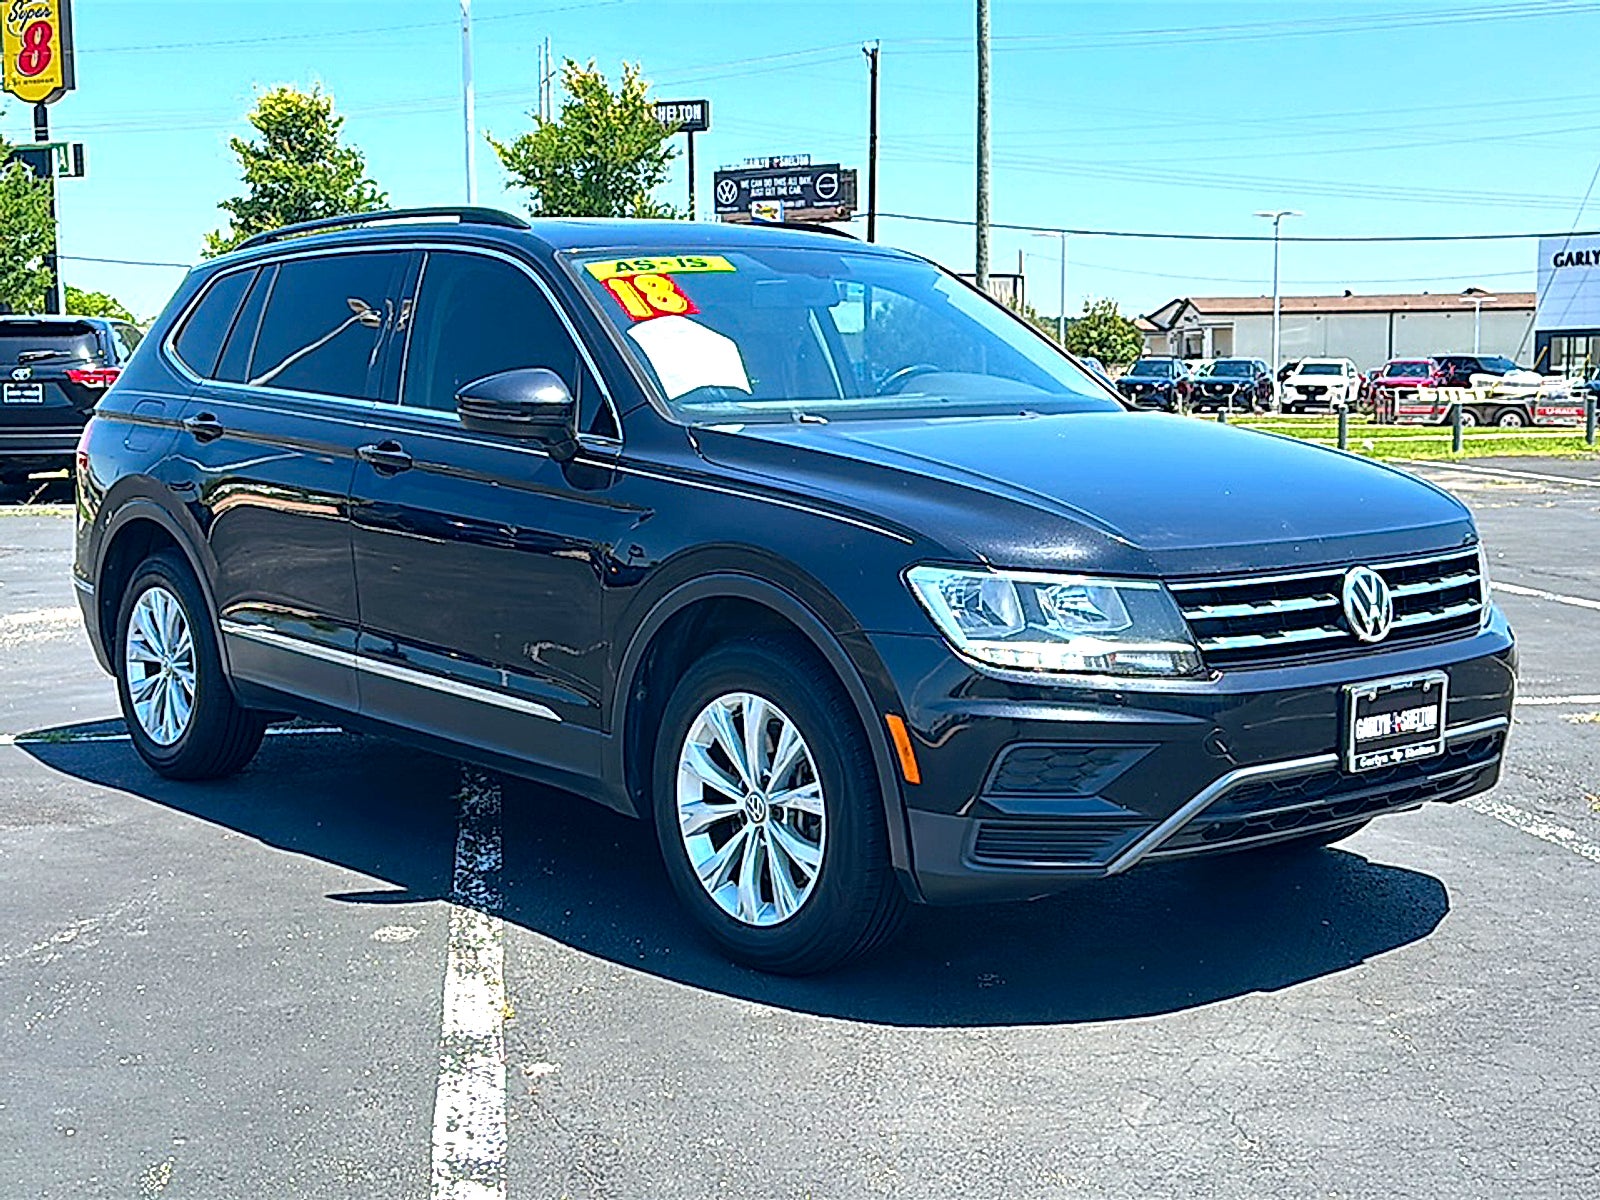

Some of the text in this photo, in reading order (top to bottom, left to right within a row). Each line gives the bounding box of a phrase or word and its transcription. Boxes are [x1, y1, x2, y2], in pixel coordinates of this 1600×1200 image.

[8, 0, 52, 32] Super
[19, 20, 52, 76] 8
[608, 273, 688, 318] 18
